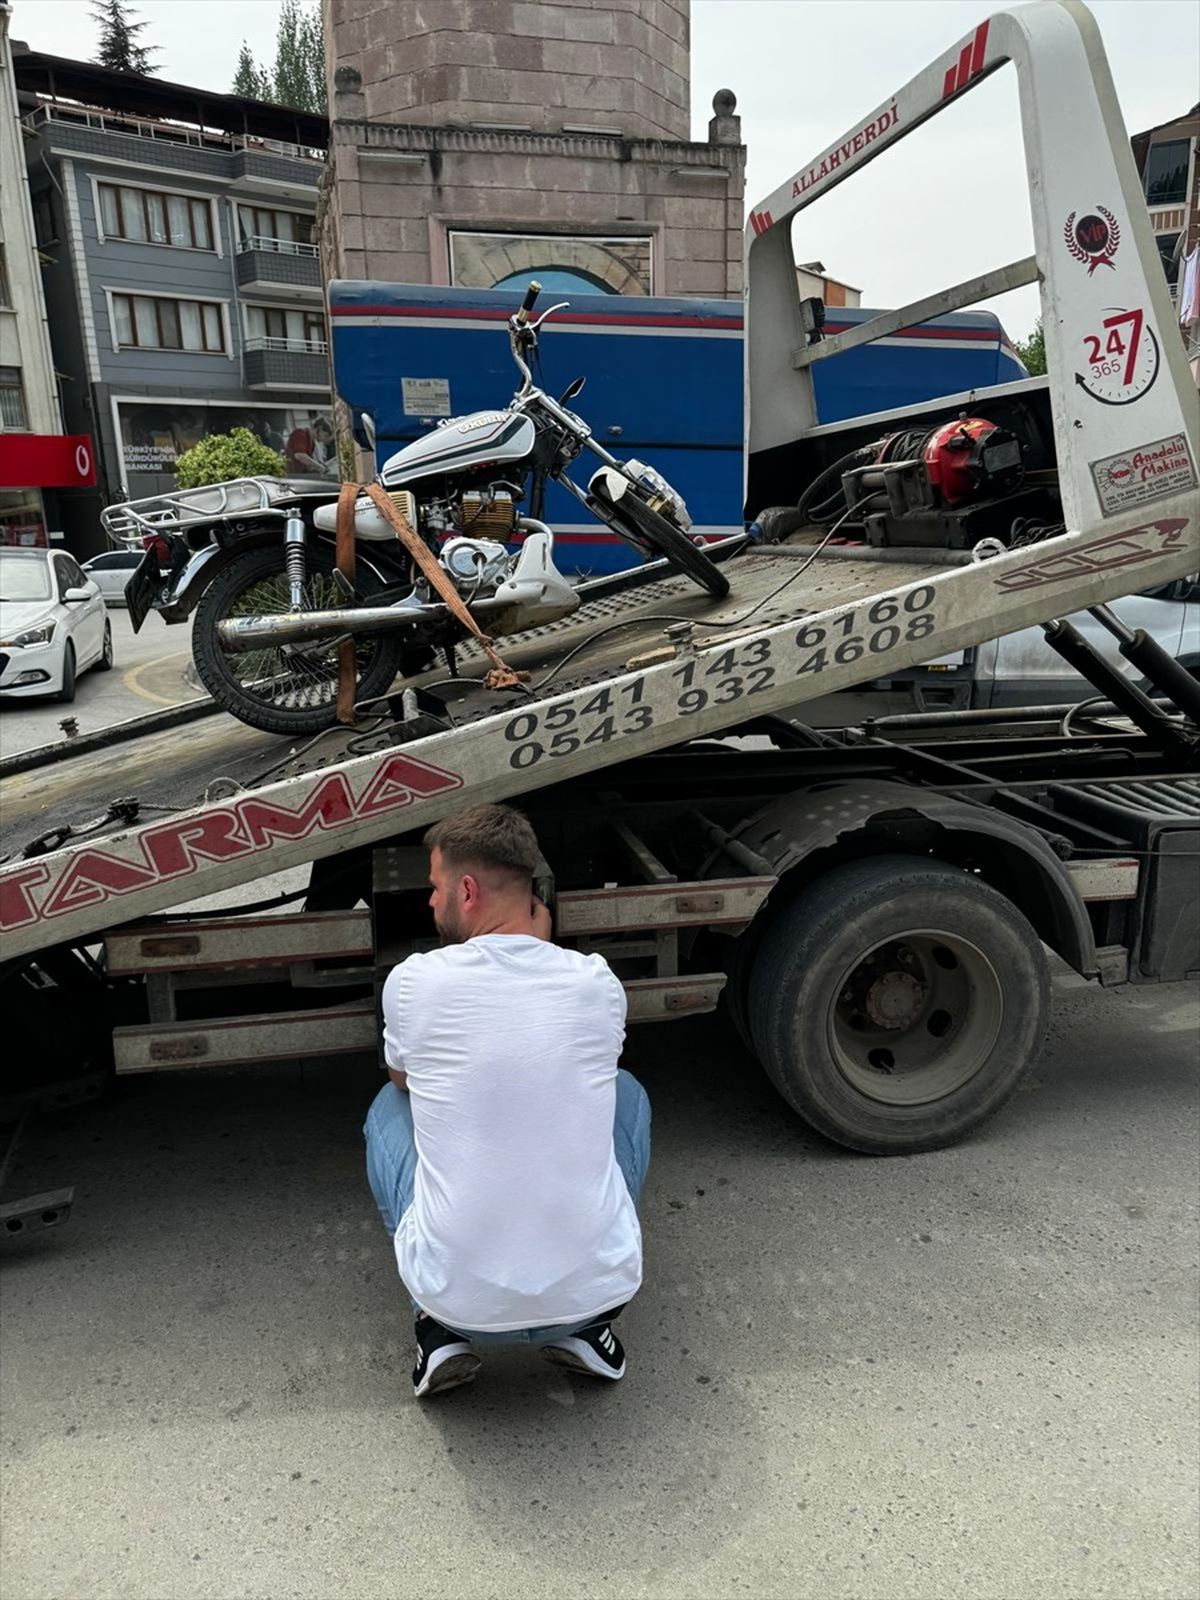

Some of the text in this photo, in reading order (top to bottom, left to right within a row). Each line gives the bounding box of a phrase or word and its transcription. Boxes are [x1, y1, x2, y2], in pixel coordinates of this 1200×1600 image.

[792, 97, 900, 199] ALLAHVERDİ
[1091, 358, 1121, 380] 365
[125, 463, 163, 471] BANKASI
[1132, 442, 1185, 470] Anadolu
[1141, 458, 1188, 482] Makina
[504, 585, 936, 742] 0541 143 6160
[509, 613, 936, 769] 0543 932 4608
